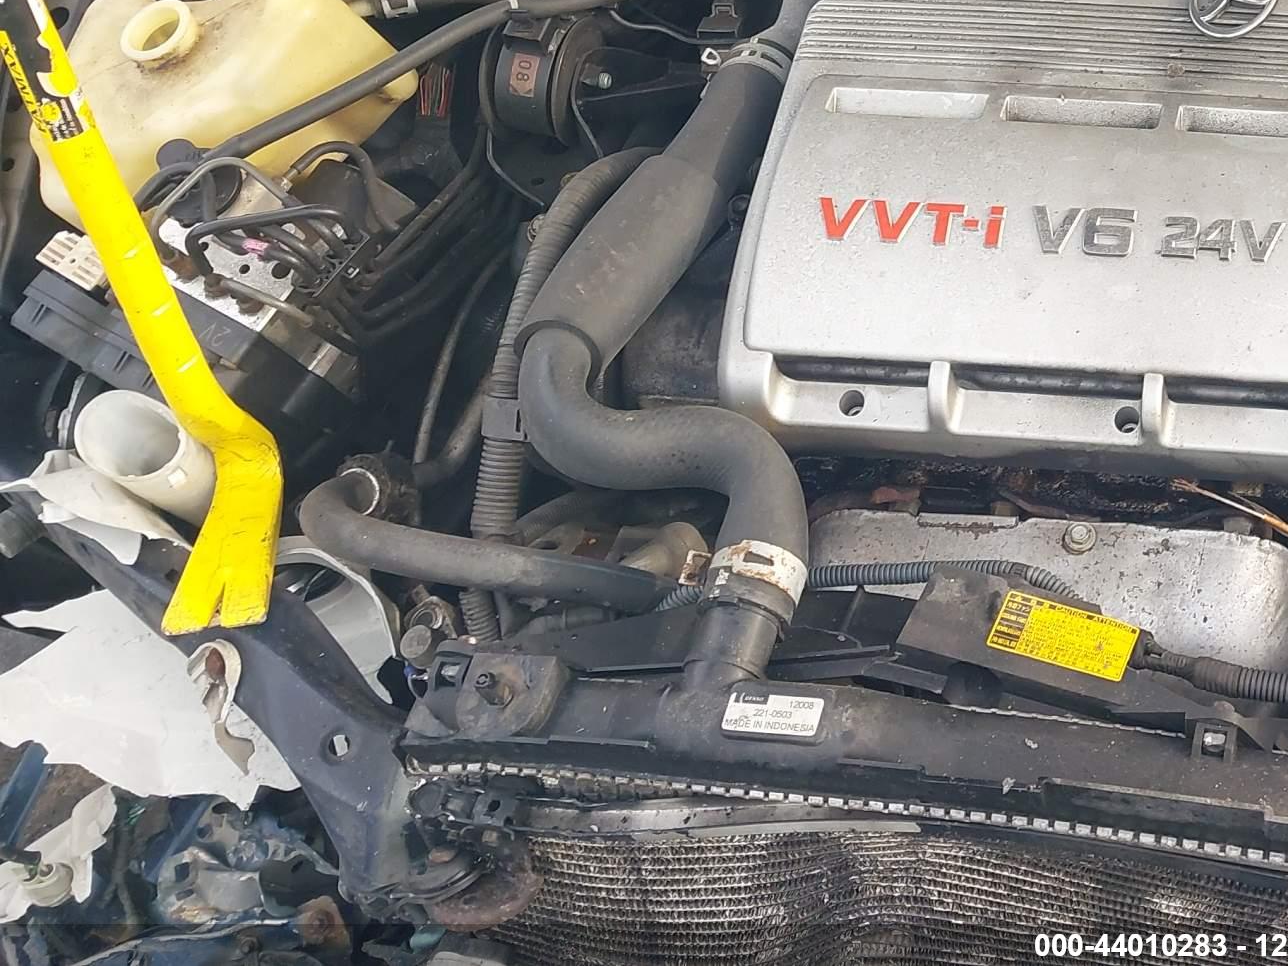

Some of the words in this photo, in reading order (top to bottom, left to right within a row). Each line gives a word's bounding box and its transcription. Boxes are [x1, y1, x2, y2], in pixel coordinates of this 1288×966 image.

[819, 196, 1008, 249] VVT-i
[1032, 204, 1139, 257] V6
[1159, 215, 1287, 263] 24V
[752, 708, 793, 719] 221-0503
[724, 718, 752, 729] MADE
[753, 720, 762, 729] IN
[763, 721, 815, 732] INDONESIA
